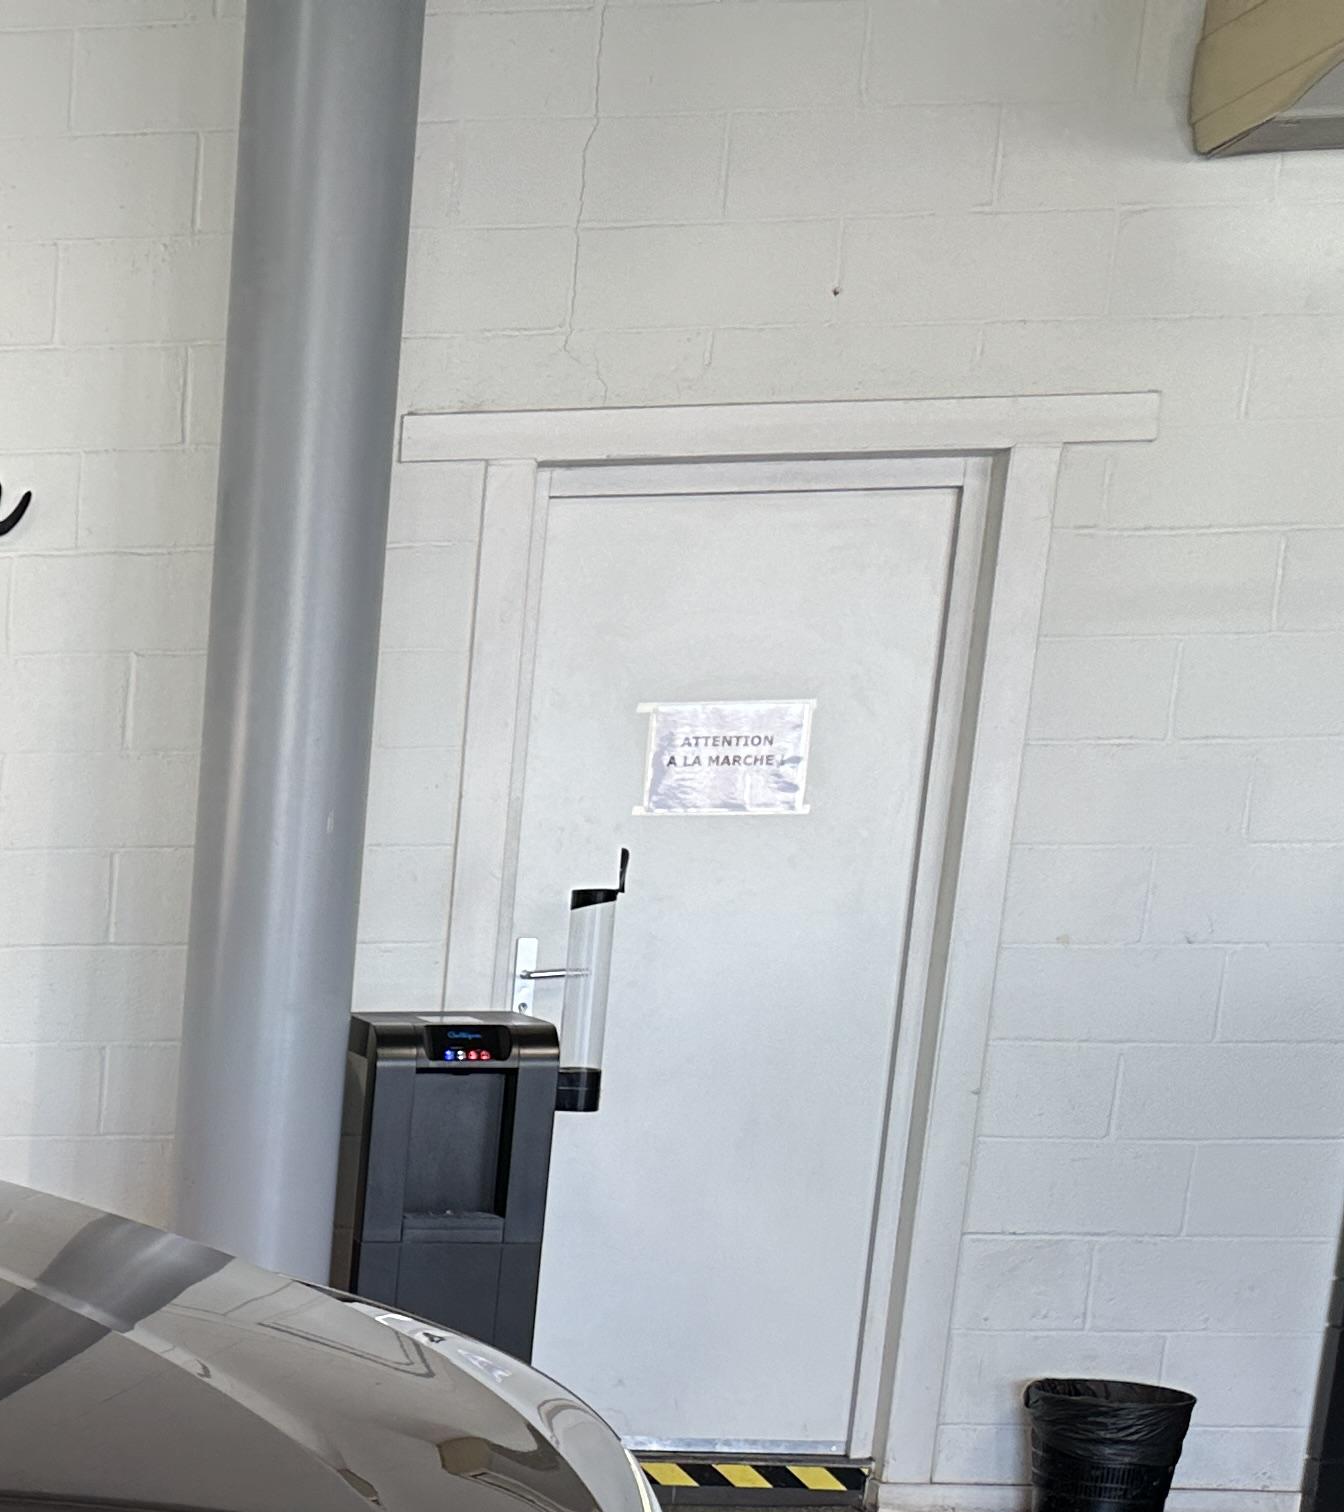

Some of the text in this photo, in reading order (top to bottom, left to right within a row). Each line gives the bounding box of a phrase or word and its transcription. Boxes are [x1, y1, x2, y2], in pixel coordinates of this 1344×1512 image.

[679, 734, 774, 748] ATTENTION
[666, 755, 677, 767] A
[683, 755, 702, 767] LA
[707, 753, 774, 767] MARCHE
